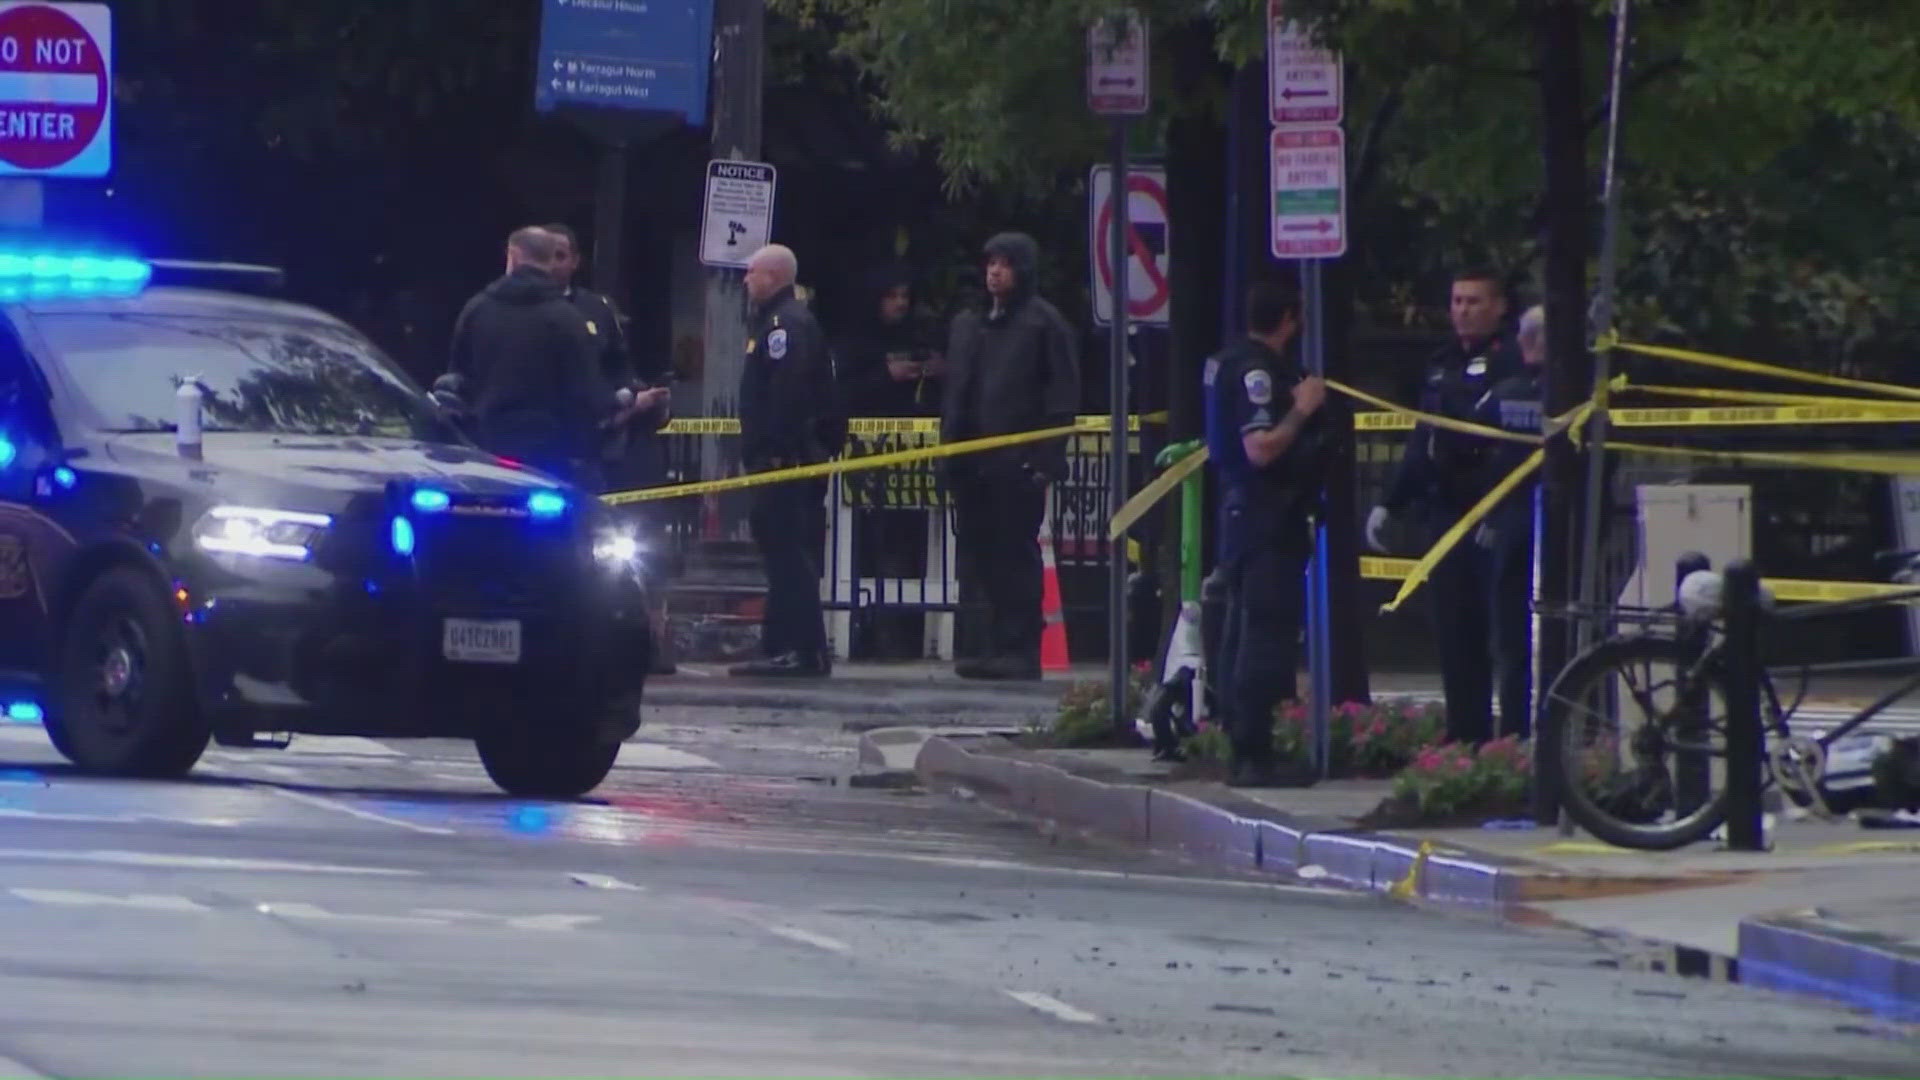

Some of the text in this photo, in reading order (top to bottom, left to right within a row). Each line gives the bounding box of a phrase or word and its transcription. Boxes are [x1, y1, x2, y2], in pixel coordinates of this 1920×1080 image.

[2, 36, 86, 65] O NOT
[625, 66, 656, 80] North
[579, 79, 622, 96] Farragut
[623, 85, 649, 97] West
[717, 164, 766, 180] NOTICE
